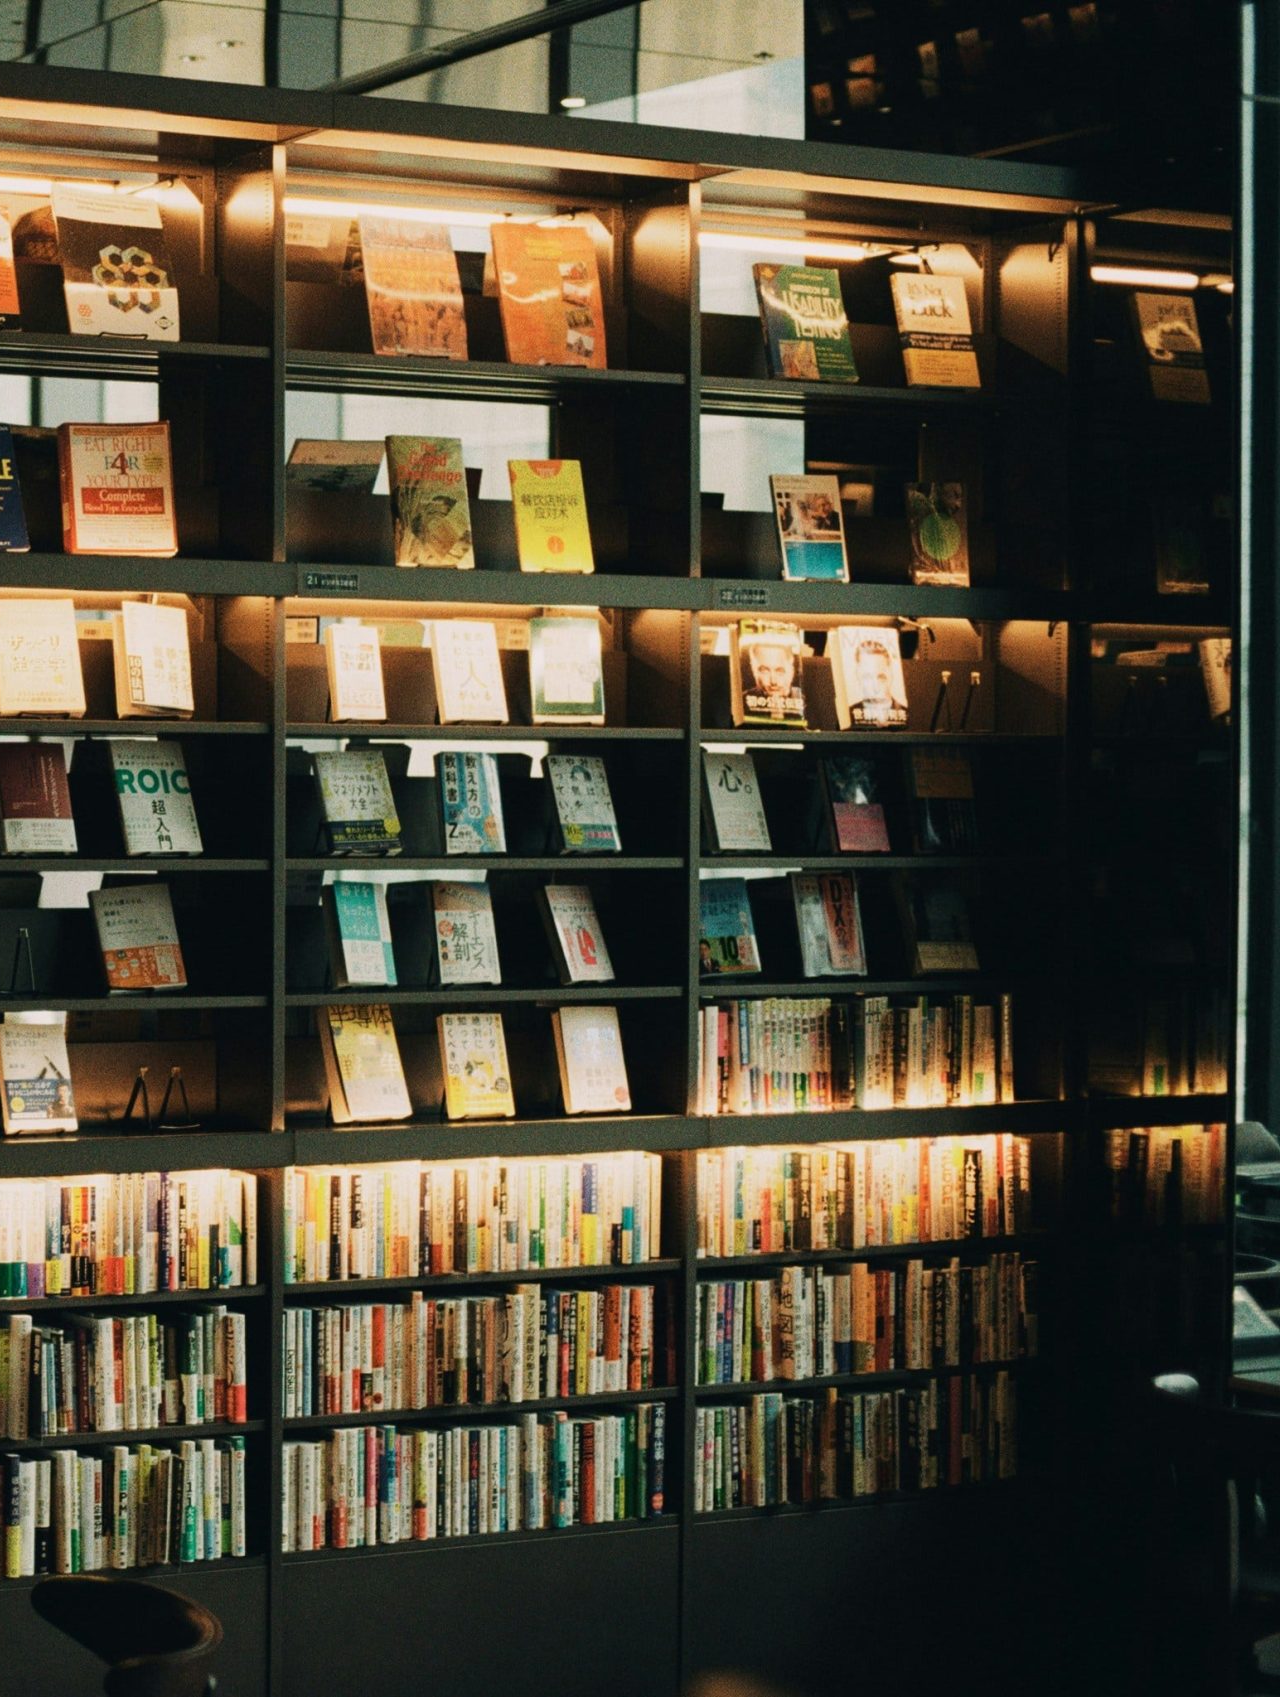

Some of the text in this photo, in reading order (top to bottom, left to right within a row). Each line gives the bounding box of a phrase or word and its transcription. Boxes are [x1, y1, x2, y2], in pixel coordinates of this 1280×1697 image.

[84, 436, 154, 452] EAT RIGHT
[99, 489, 146, 504] Complete
[307, 575, 318, 585] 21
[115, 768, 192, 795] ROIC
[719, 764, 753, 793] 心。
[151, 799, 173, 851] 超入門
[452, 922, 470, 962] 解剖
[468, 912, 486, 970] キーエンス
[286, 1350, 295, 1395] Deep Skill
